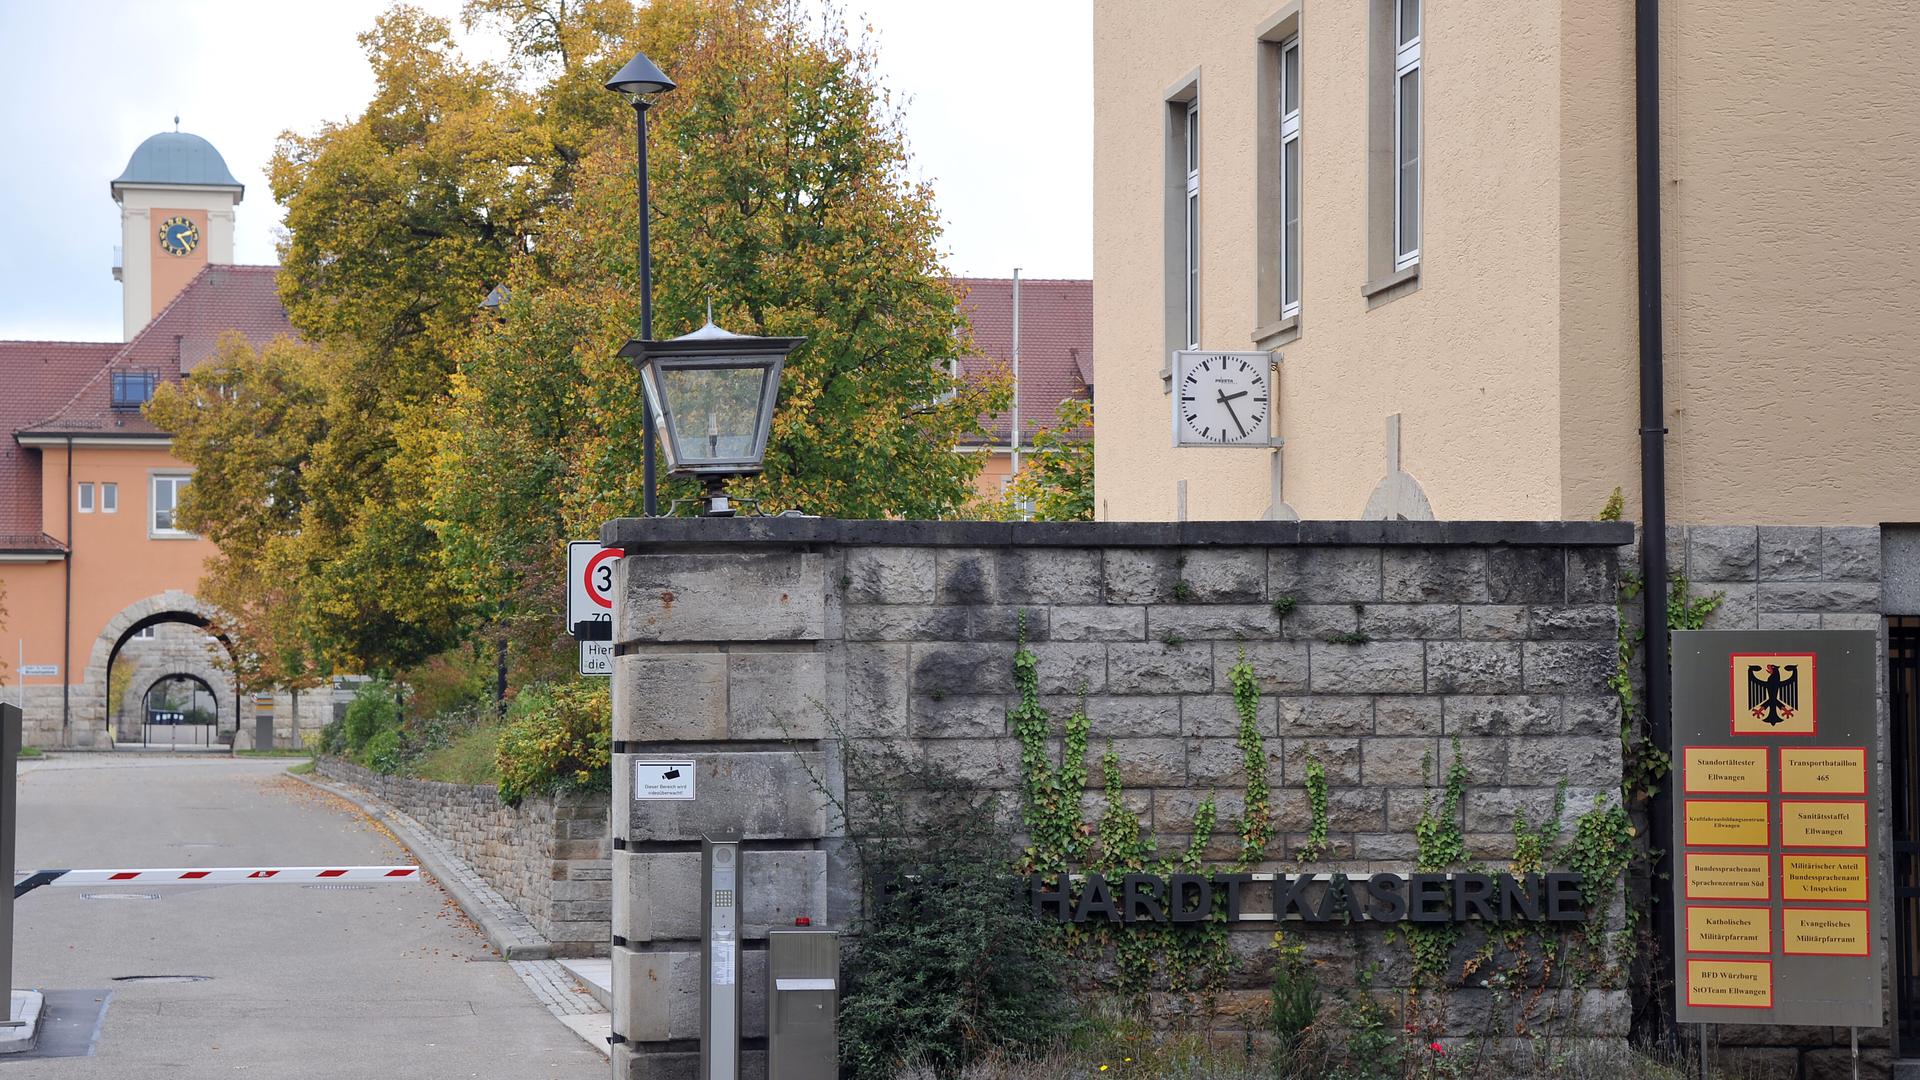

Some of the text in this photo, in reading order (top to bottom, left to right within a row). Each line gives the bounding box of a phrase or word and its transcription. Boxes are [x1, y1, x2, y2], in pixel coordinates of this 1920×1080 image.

[597, 565, 612, 592] 3
[588, 645, 613, 655] Hier
[588, 659, 605, 669] die
[1789, 759, 1857, 768] Transportbataillon
[1708, 773, 1745, 782] Ellwangen
[1816, 774, 1830, 782] 465
[1798, 812, 1850, 820] Sanitätsstaffel
[1805, 828, 1843, 836] Ellwangen
[1695, 865, 1761, 874] Bundessprachenamt
[1790, 862, 1836, 870] Militärischer
[1789, 873, 1860, 882] Bundessprachenamt
[1691, 880, 1750, 888] Sprachenzentrum
[1810, 885, 1847, 894] Inspektion
[875, 873, 1587, 922] HARDT KASERNE
[1706, 918, 1752, 926] Katholisches
[1800, 920, 1851, 928] Evangelisches
[1700, 933, 1758, 942] Militärpfarramt
[1796, 935, 1855, 944] Militärpfarramt
[1701, 971, 1758, 981] BFD Würzburg
[1692, 986, 1766, 996] StOTeam Ellwangen
